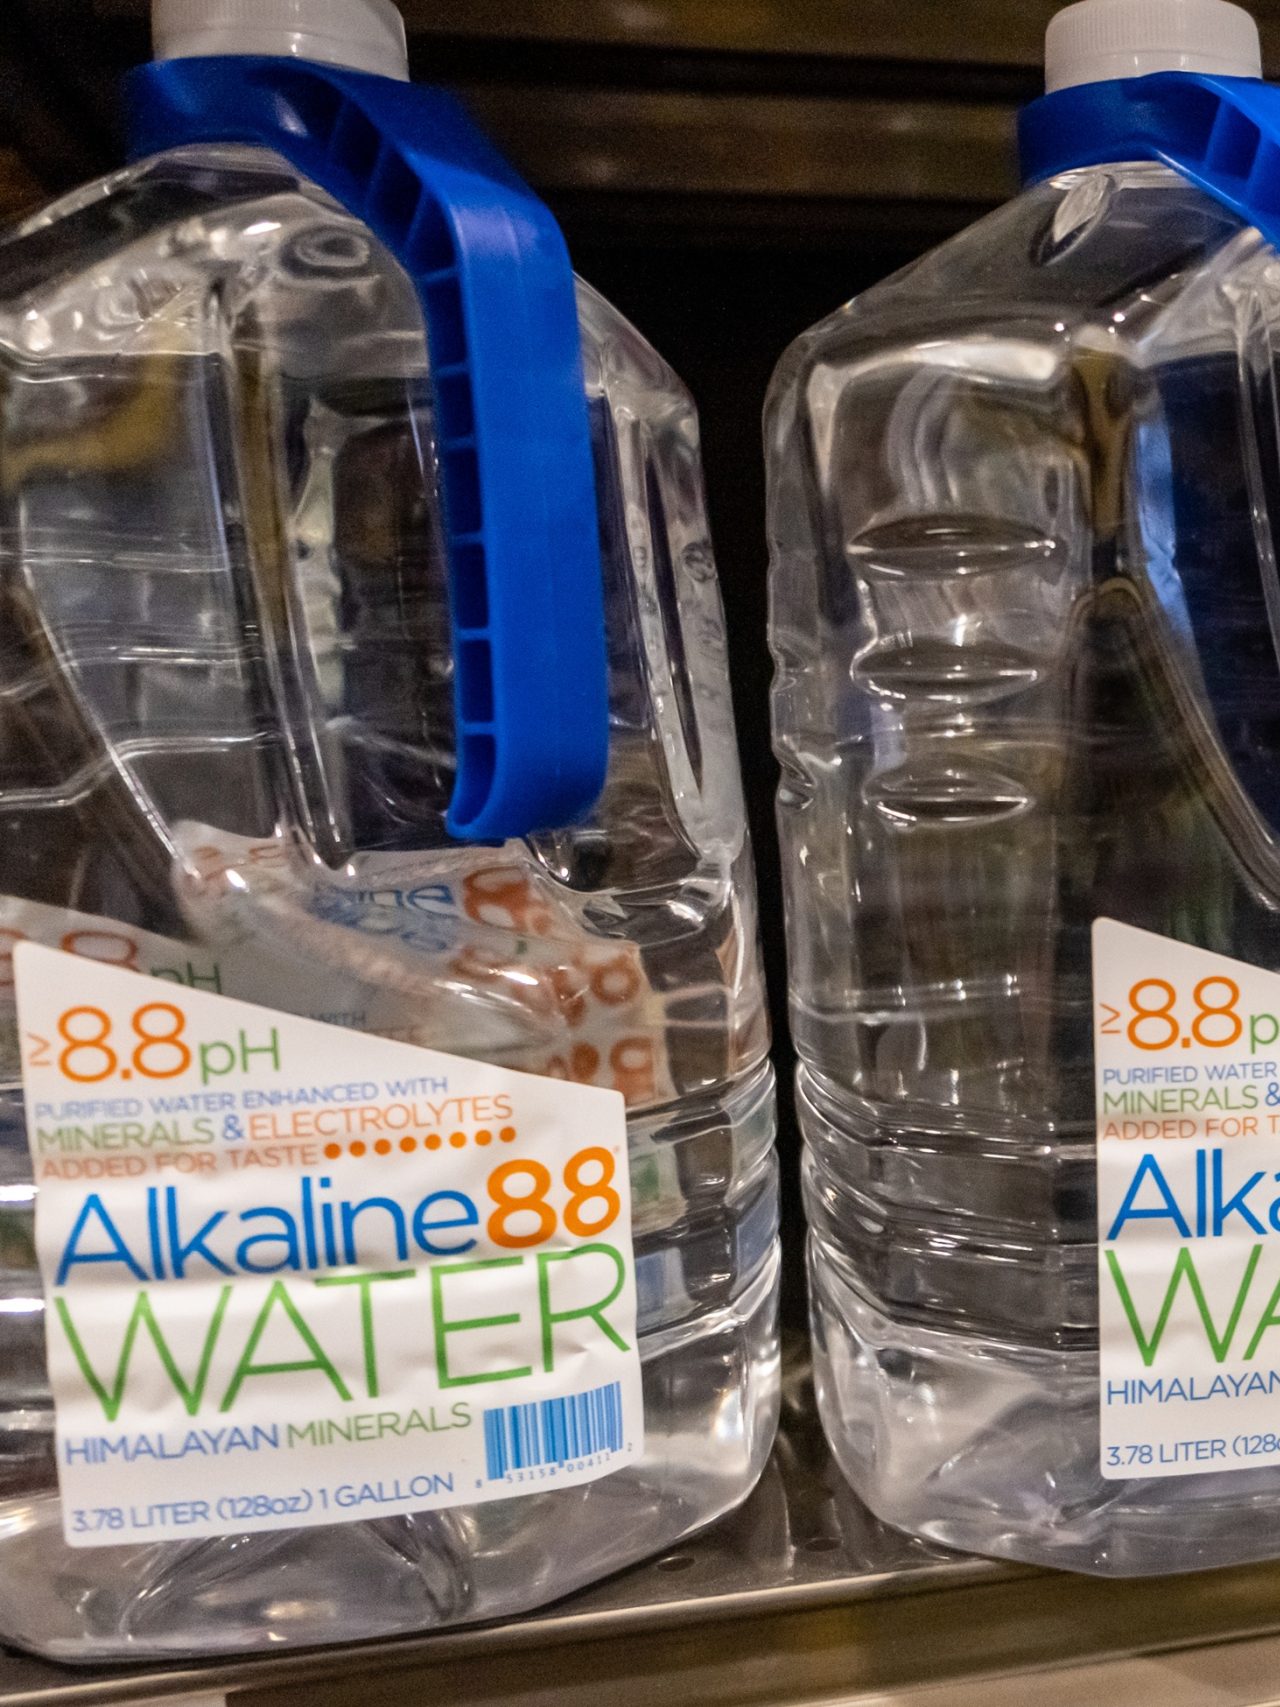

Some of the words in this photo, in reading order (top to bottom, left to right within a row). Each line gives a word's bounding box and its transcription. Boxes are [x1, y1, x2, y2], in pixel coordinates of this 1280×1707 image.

[199, 1028, 280, 1085] pH
[1103, 1066, 1198, 1085] PURIFIED
[1204, 1061, 1278, 1081] WATER
[34, 1098, 143, 1120] PURIFIED
[150, 1092, 236, 1115] WATER
[243, 1082, 379, 1109] ENHANCED
[387, 1077, 448, 1097] WITH
[36, 1117, 215, 1153] MINERALS
[222, 1114, 244, 1141] &
[249, 1094, 513, 1141] ELECTROLYTES
[1103, 1085, 1259, 1115] MINERALS
[1102, 1119, 1198, 1141] ADDED
[1205, 1116, 1259, 1138] FOR
[41, 1154, 147, 1181] ADDED
[154, 1150, 217, 1173] FOR
[228, 1144, 319, 1169] TASTE
[55, 1146, 621, 1287] Alkaline88
[54, 1243, 631, 1422] WATER
[65, 1423, 279, 1464] HIMALAYAN
[286, 1402, 472, 1448] MINERALS
[1106, 1445, 1153, 1466] 3.78
[1159, 1439, 1226, 1463] LITER
[71, 1507, 125, 1532] 3.78
[131, 1500, 210, 1527] LITER
[216, 1488, 313, 1521] (128oz)
[319, 1489, 329, 1509] 1
[335, 1472, 454, 1507] GALLON
